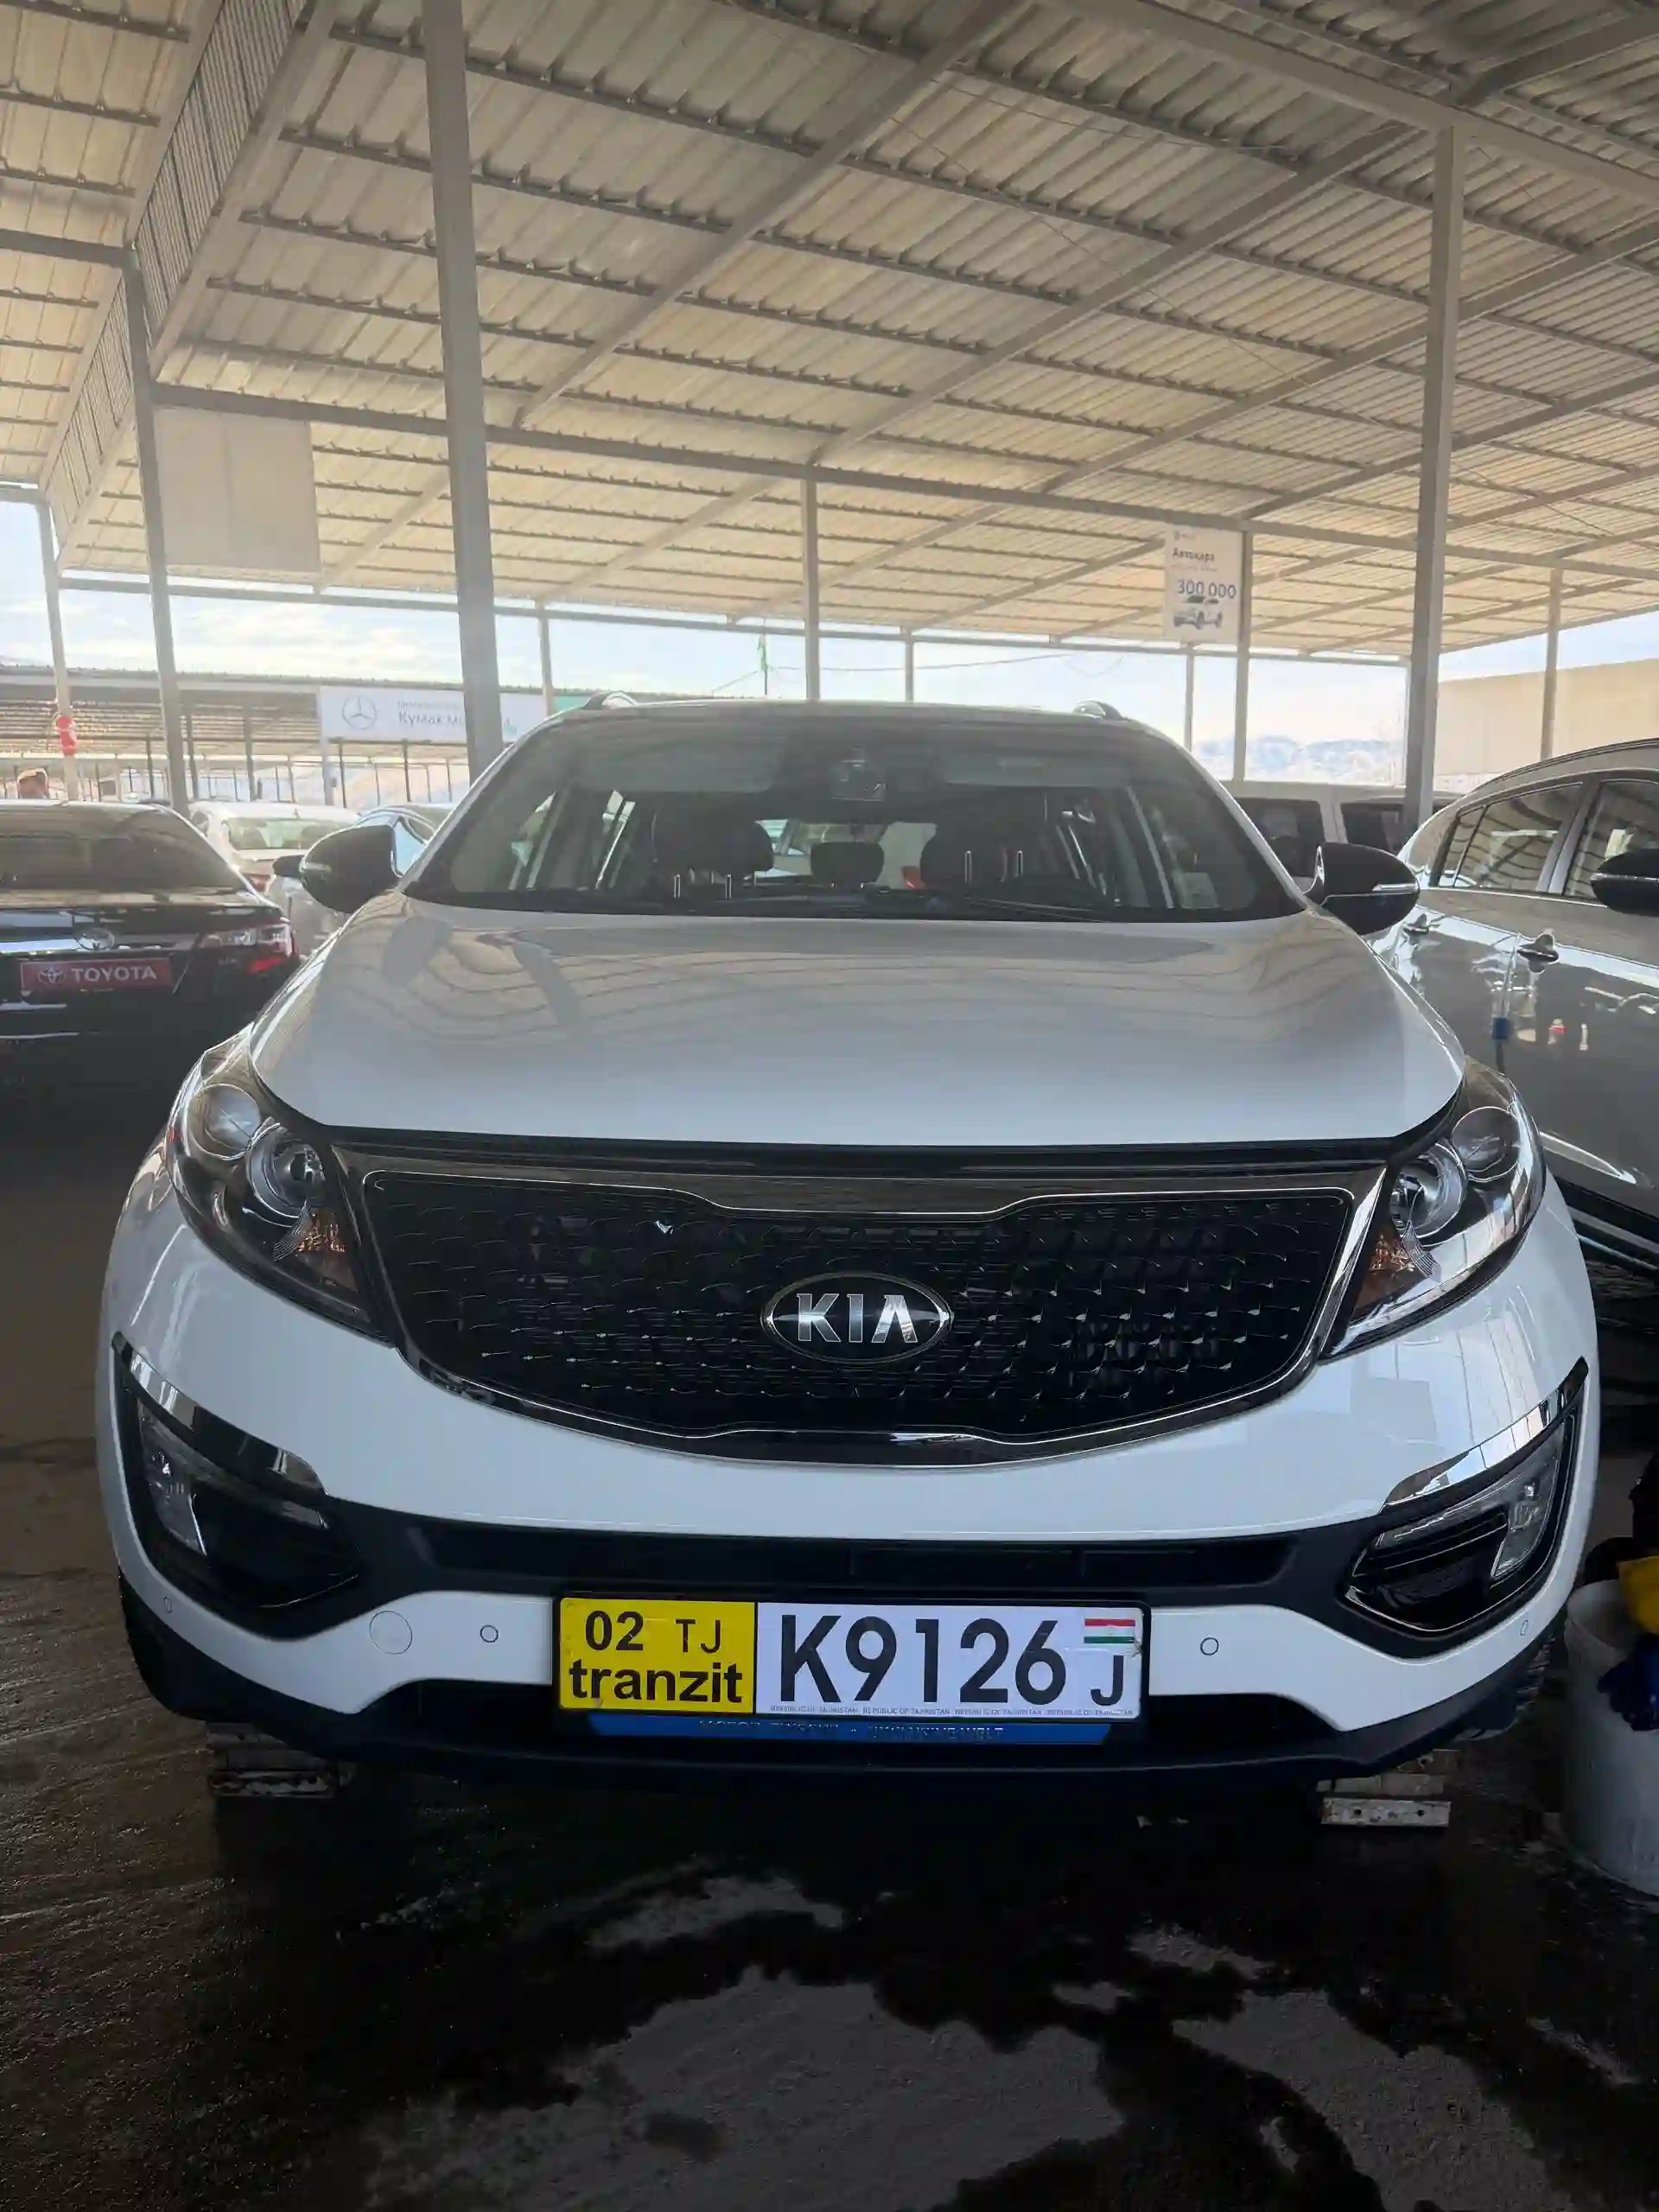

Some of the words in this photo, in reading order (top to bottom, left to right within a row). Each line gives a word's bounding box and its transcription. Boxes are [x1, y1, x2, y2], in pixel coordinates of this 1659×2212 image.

[1178, 578, 1205, 595] 300
[1208, 582, 1236, 599] 000
[72, 965, 157, 982] TOYOTA
[796, 1293, 918, 1344] KIA
[585, 1610, 644, 1651] 02
[675, 1618, 722, 1654] TJ
[569, 1658, 743, 1703] tranzit
[780, 1614, 1067, 1706] K9126
[1090, 1655, 1124, 1706] J
